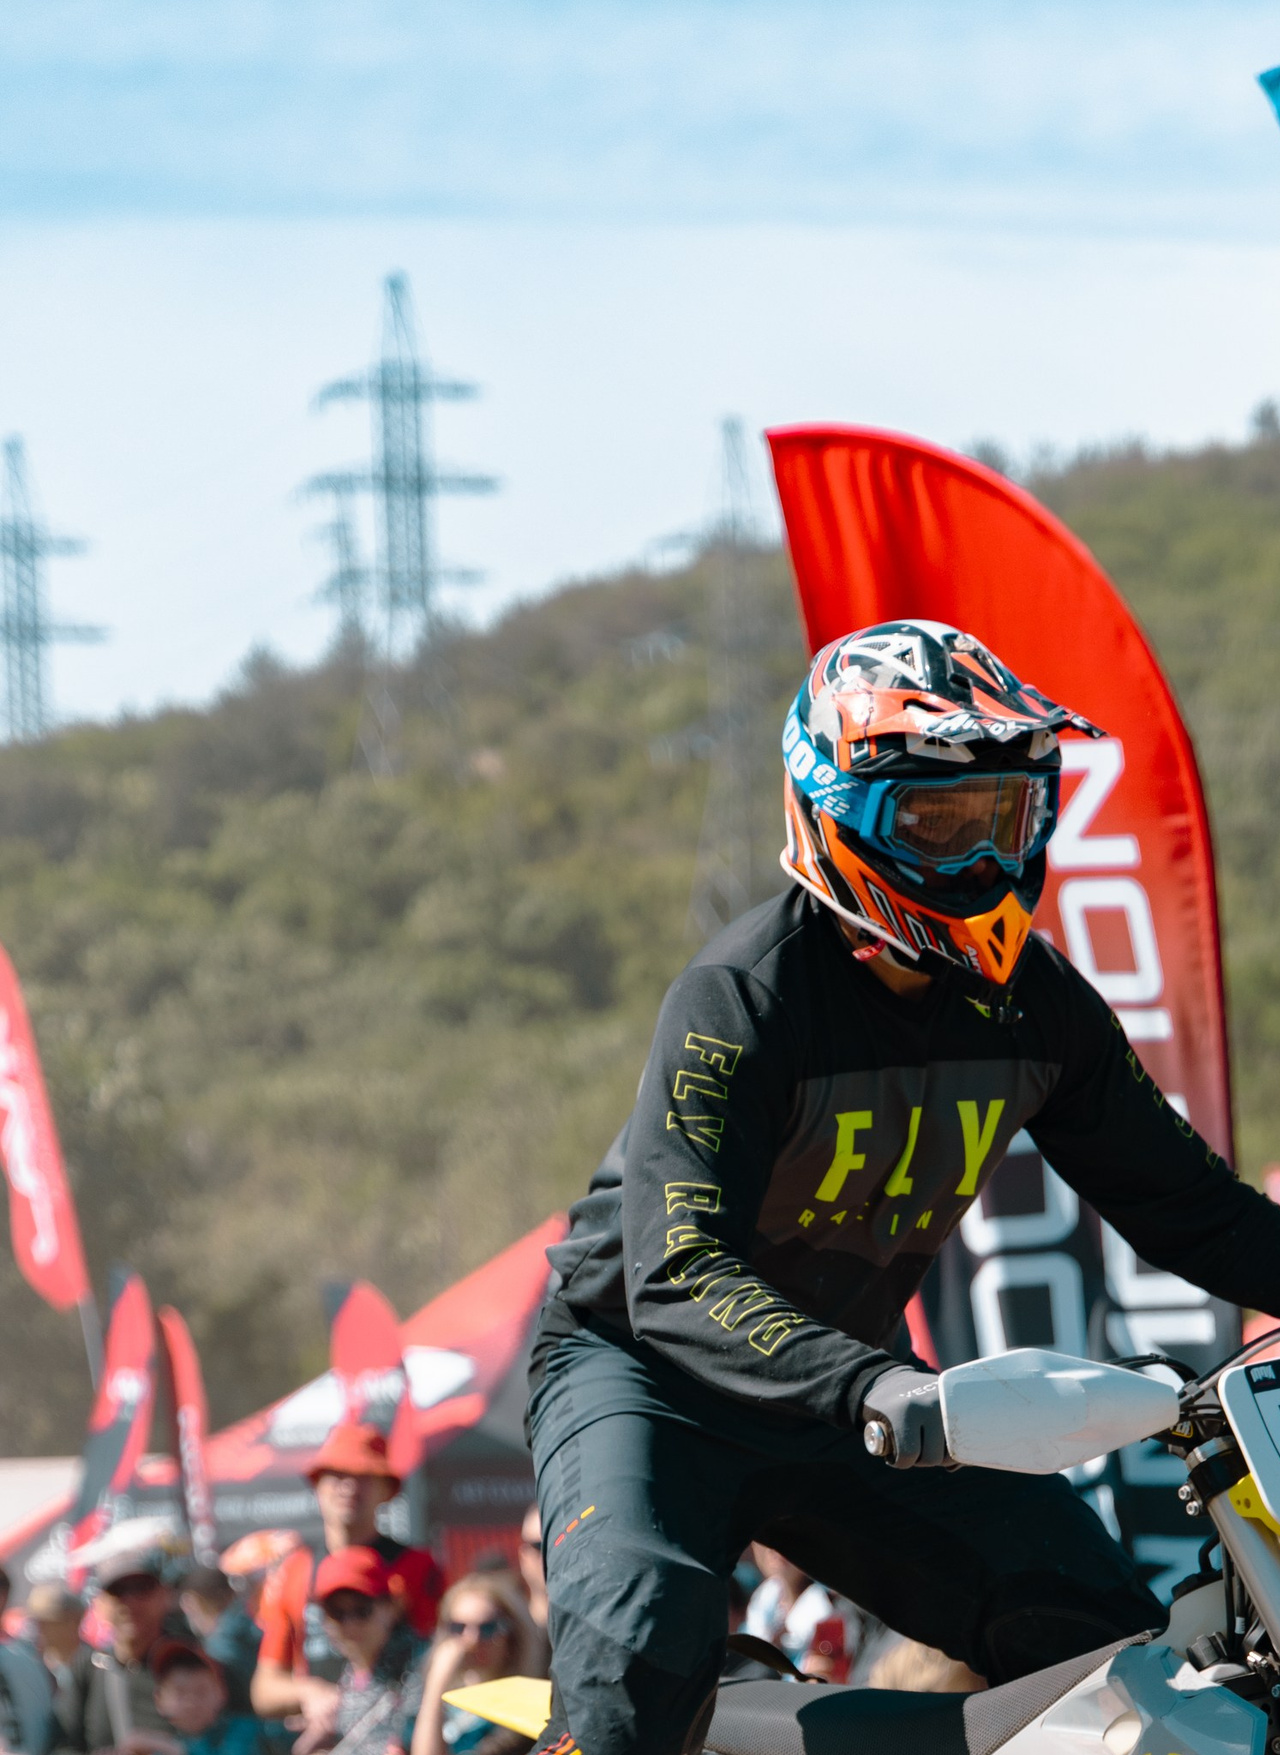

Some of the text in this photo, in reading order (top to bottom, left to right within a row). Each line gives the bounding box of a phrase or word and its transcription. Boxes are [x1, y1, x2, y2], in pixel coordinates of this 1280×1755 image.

[663, 1032, 804, 1356] FLY RACING
[815, 1099, 1005, 1202] FLY
